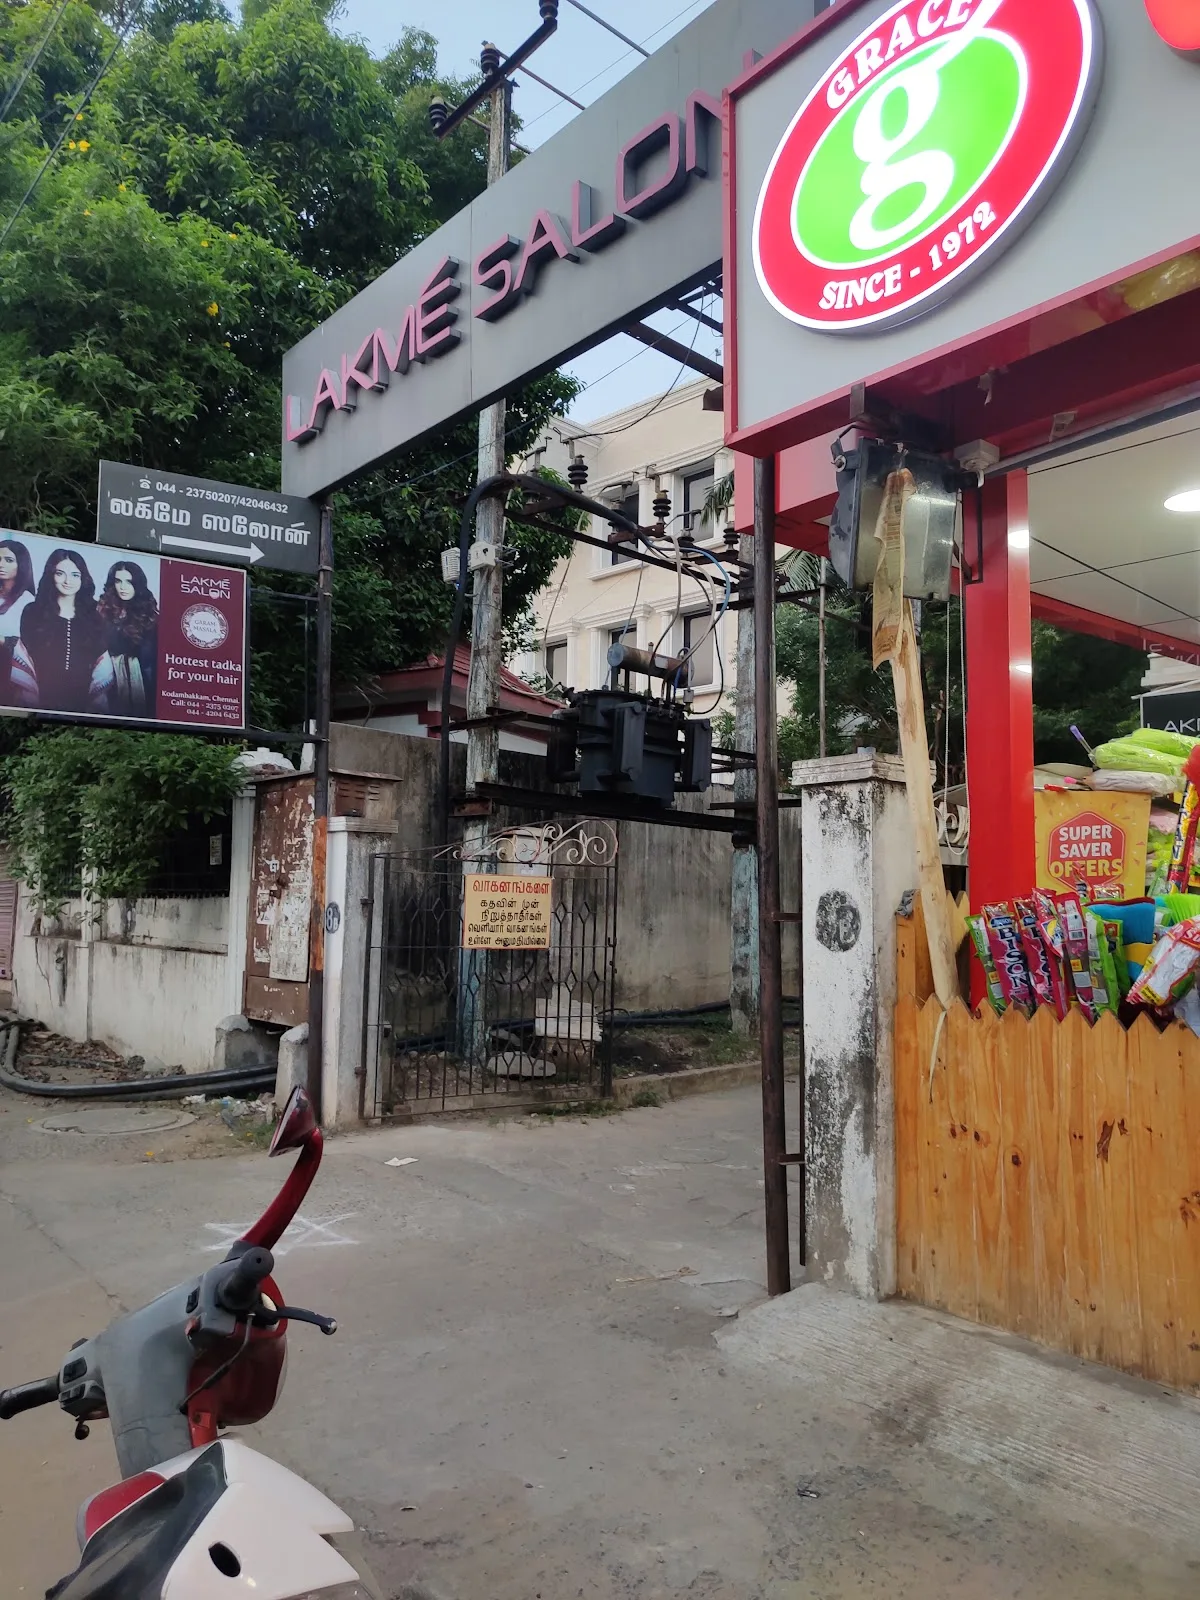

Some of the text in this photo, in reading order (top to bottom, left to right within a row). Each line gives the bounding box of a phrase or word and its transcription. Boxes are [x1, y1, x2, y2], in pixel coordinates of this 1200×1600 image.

[826, 0, 973, 109] GRACE
[818, 264, 902, 311] SINCE
[928, 201, 998, 273] 1972
[286, 255, 461, 444] LAKMÉ
[156, 481, 176, 494] 044
[186, 487, 289, 514] 23750207/42046432
[110, 495, 191, 526] லக்மே
[181, 584, 231, 599] SALON
[193, 625, 218, 634] MASALA
[165, 653, 242, 672] Hottest tadka
[168, 667, 239, 685] for your hair
[1059, 824, 1113, 842] SUPER
[1059, 842, 1113, 859] SAVER
[473, 880, 550, 894] வாகனங்களை
[480, 897, 540, 910] கதவின் முன்
[997, 927, 1031, 988] BISON
